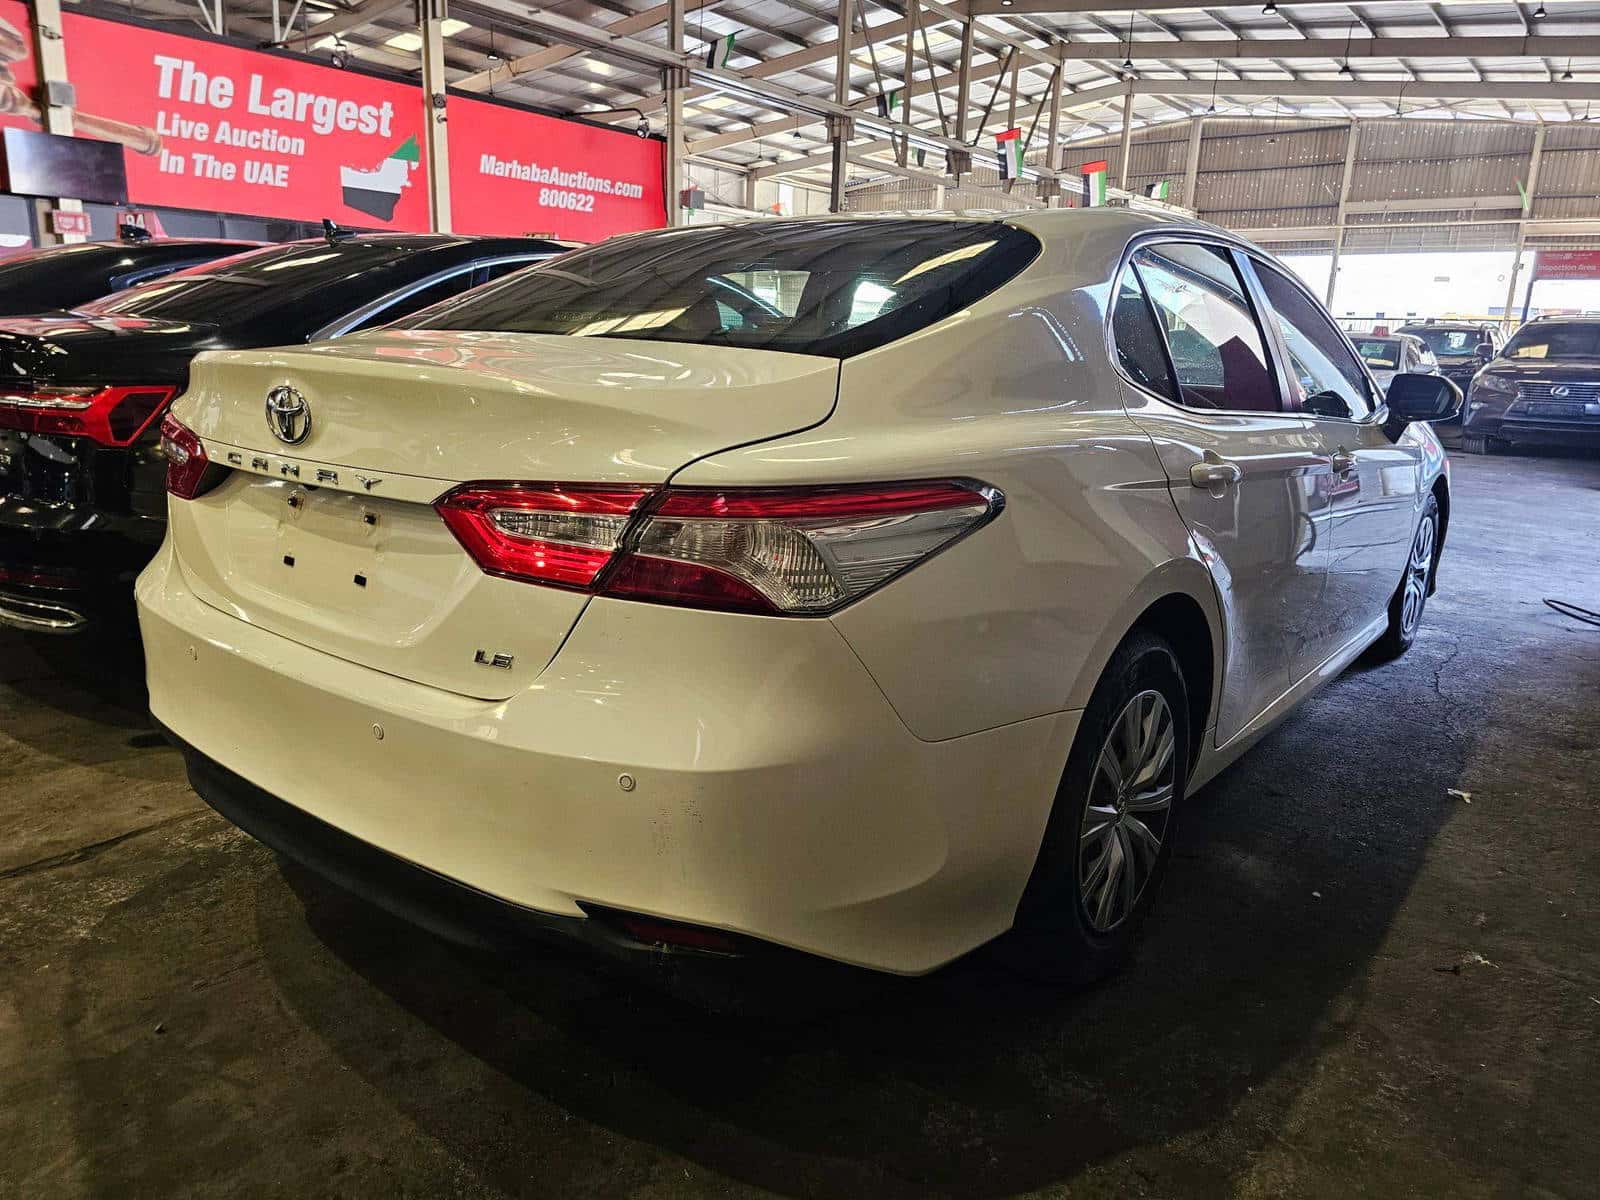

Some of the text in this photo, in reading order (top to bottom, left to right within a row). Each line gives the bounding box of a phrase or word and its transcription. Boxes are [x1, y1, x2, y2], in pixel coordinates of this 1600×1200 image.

[154, 55, 394, 138] The Largest
[156, 111, 306, 157] Live Auction
[159, 149, 290, 188] In The UAE
[479, 153, 644, 200] MarhabaAuctions.com
[538, 188, 596, 213] 800622
[227, 452, 384, 491] CAMRY
[474, 649, 514, 670] LE
